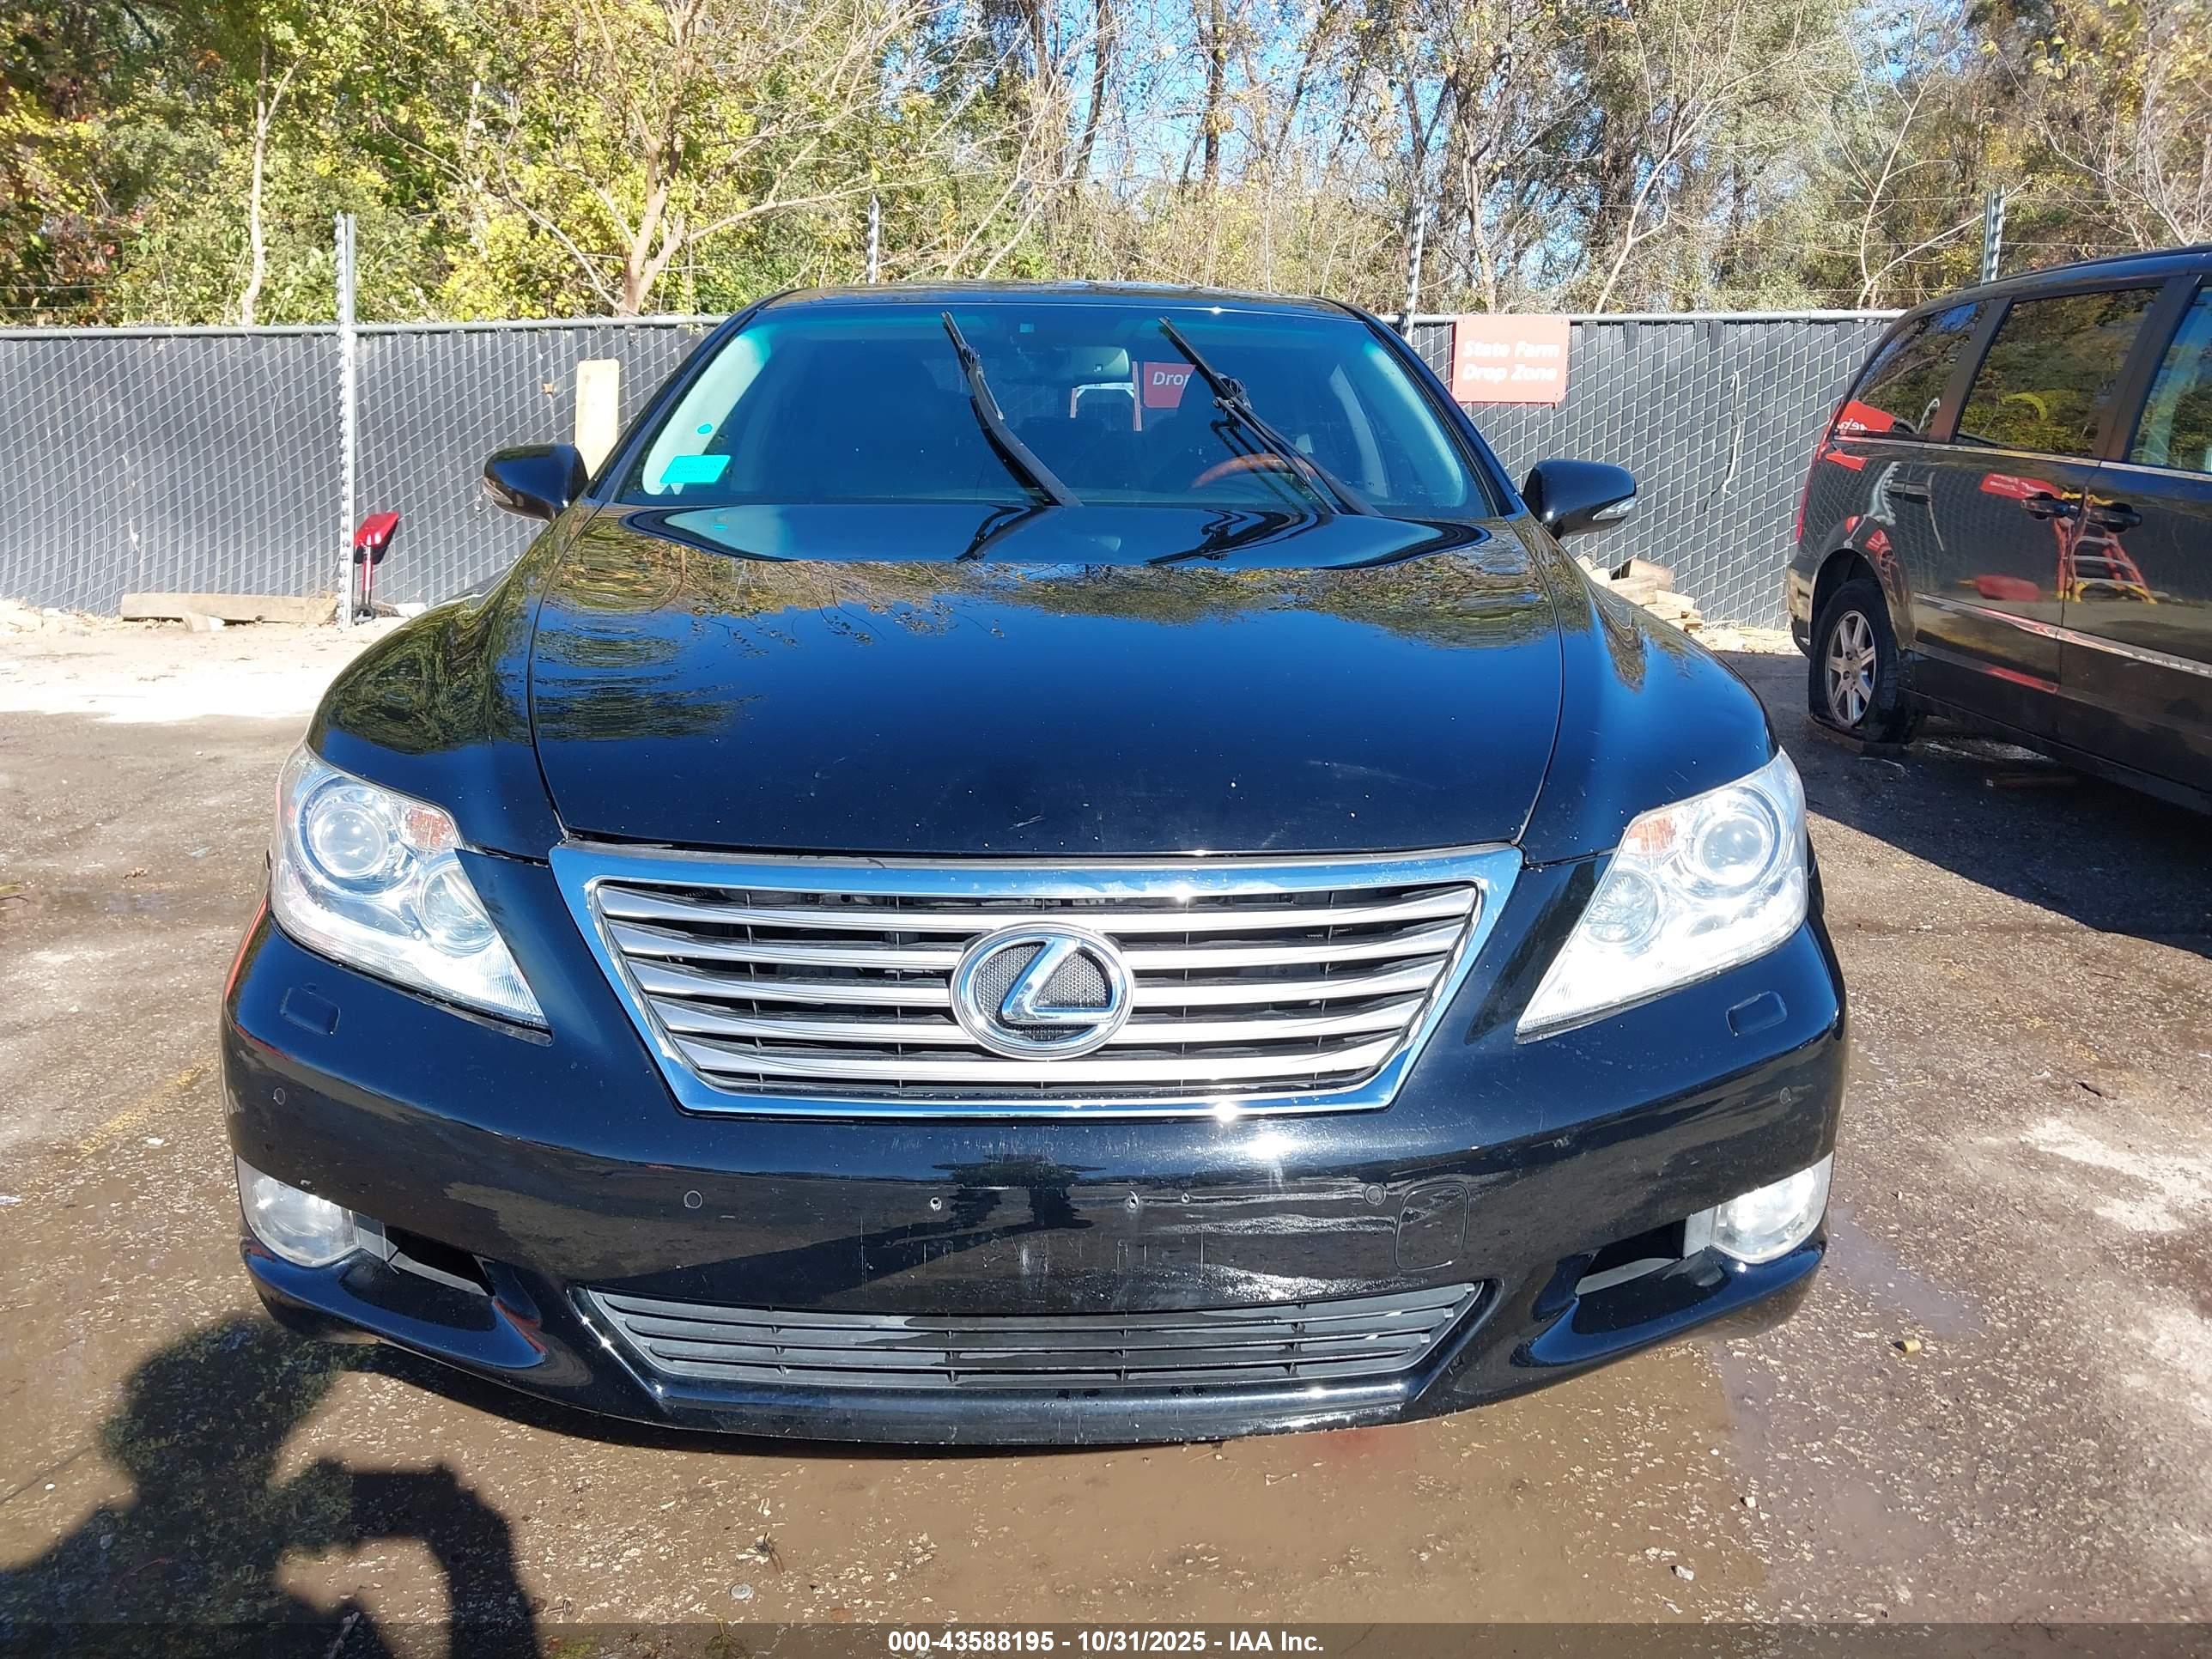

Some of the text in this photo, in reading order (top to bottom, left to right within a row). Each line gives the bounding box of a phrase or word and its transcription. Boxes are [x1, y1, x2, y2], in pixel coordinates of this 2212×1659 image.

[1462, 339, 1560, 358] State Farm
[1462, 363, 1558, 384] Drop Zone
